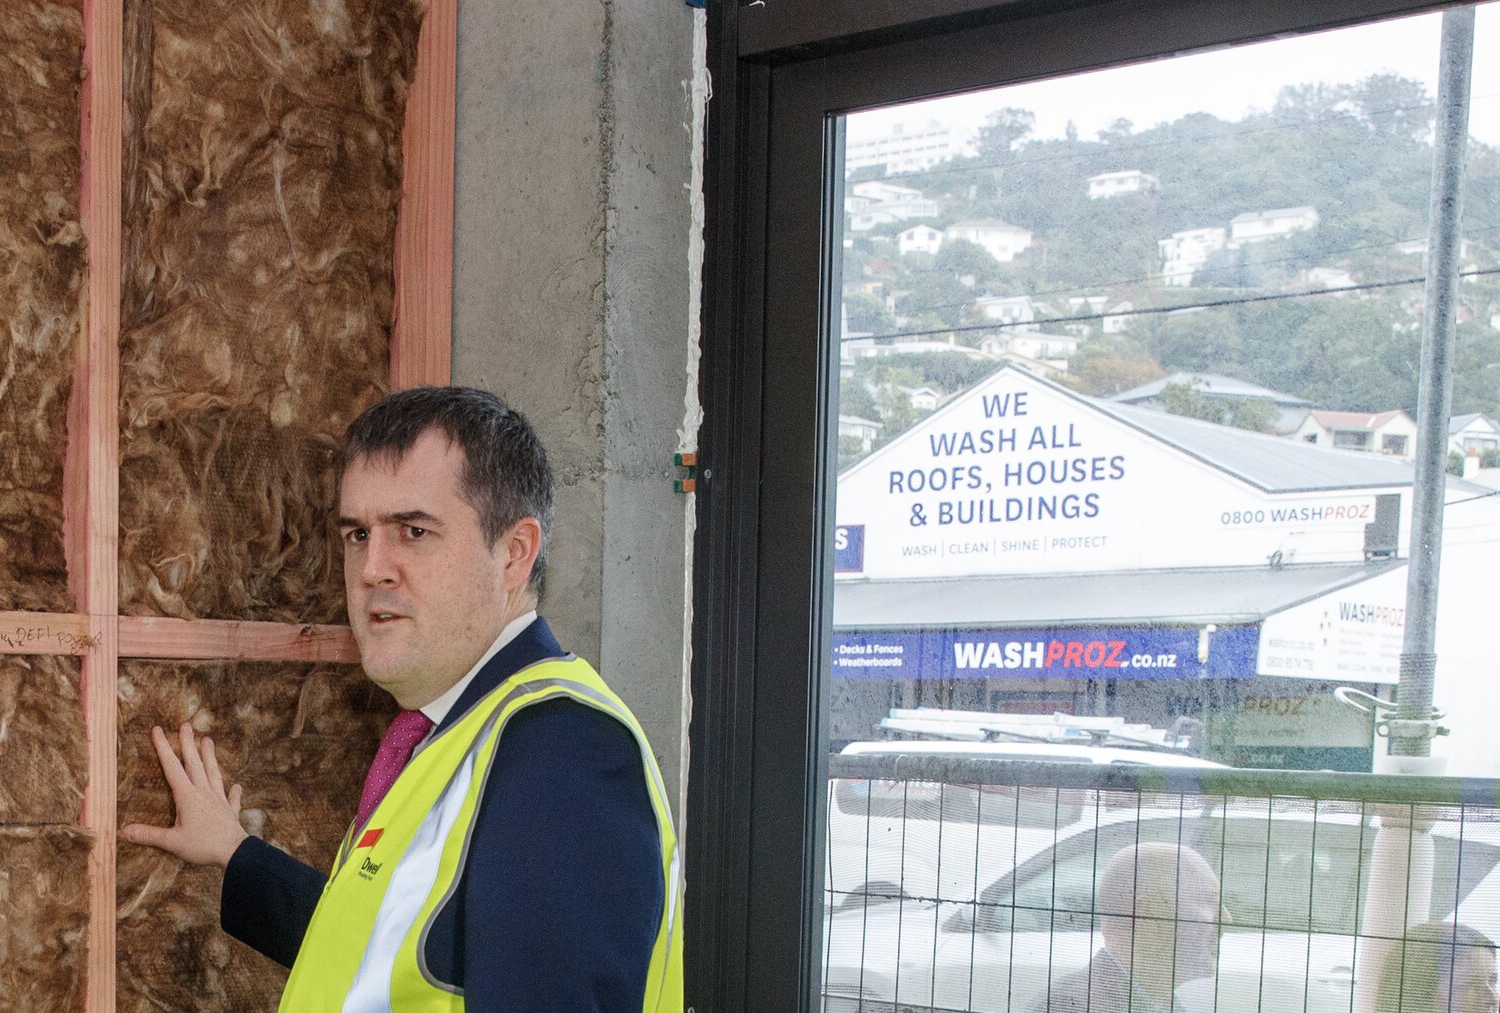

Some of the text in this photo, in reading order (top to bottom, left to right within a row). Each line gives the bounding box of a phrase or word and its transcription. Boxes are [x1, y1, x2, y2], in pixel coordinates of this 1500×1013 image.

[982, 392, 1028, 419] WE
[929, 423, 1082, 457] WASH ALL
[889, 455, 1126, 494] ROOFS, HOUSES
[910, 493, 1100, 527] & BUILDINGS
[1220, 504, 1370, 525] 0800 WASHPROZ
[901, 536, 1108, 556] WASH CLEAN SHINE PROTECT
[1339, 602, 1404, 627] WASHPROZ
[839, 644, 903, 655] Decks & Fences
[839, 657, 902, 667] Weatherboards
